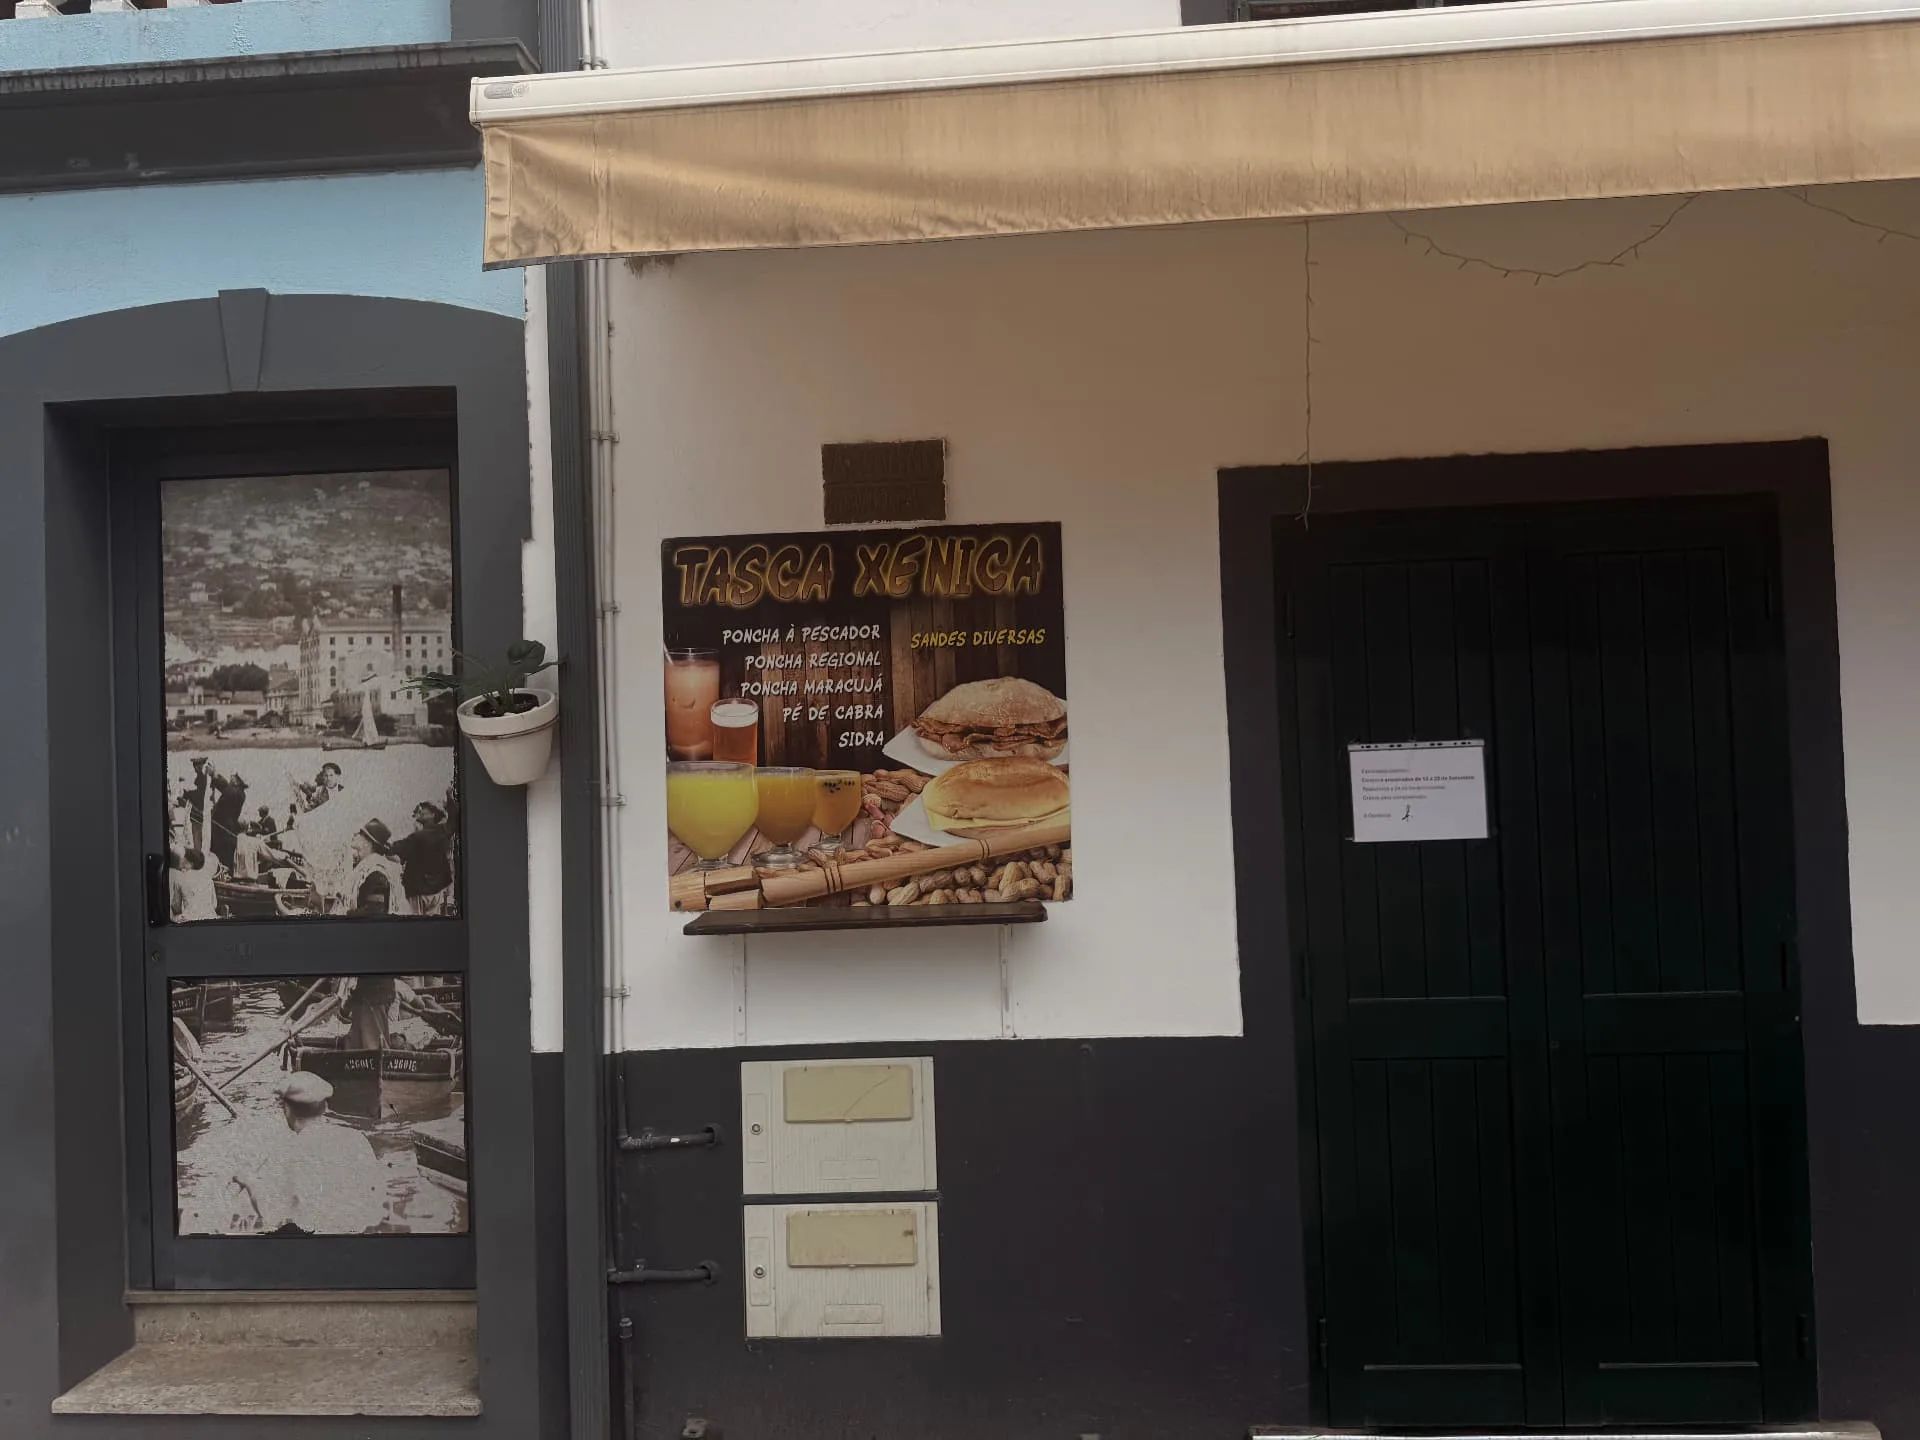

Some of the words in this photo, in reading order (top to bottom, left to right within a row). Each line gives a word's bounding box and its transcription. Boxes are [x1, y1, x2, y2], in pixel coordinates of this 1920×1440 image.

[674, 543, 834, 607] TASCA
[853, 534, 1043, 596] XENICA
[722, 627, 780, 645] PONCHA
[786, 624, 795, 643] À
[801, 624, 881, 642] PESCADOR
[911, 629, 967, 649] SANDES
[973, 628, 1046, 646] DIVERSAS
[744, 653, 802, 670] PONCHA
[809, 650, 881, 669] REGIONAL
[740, 680, 798, 697] PONCHA
[803, 673, 883, 695] MARACUJÁ
[783, 703, 803, 722] PÉ
[808, 704, 830, 721] DE
[835, 703, 884, 720] CABRA
[838, 730, 885, 748] SIDRA
